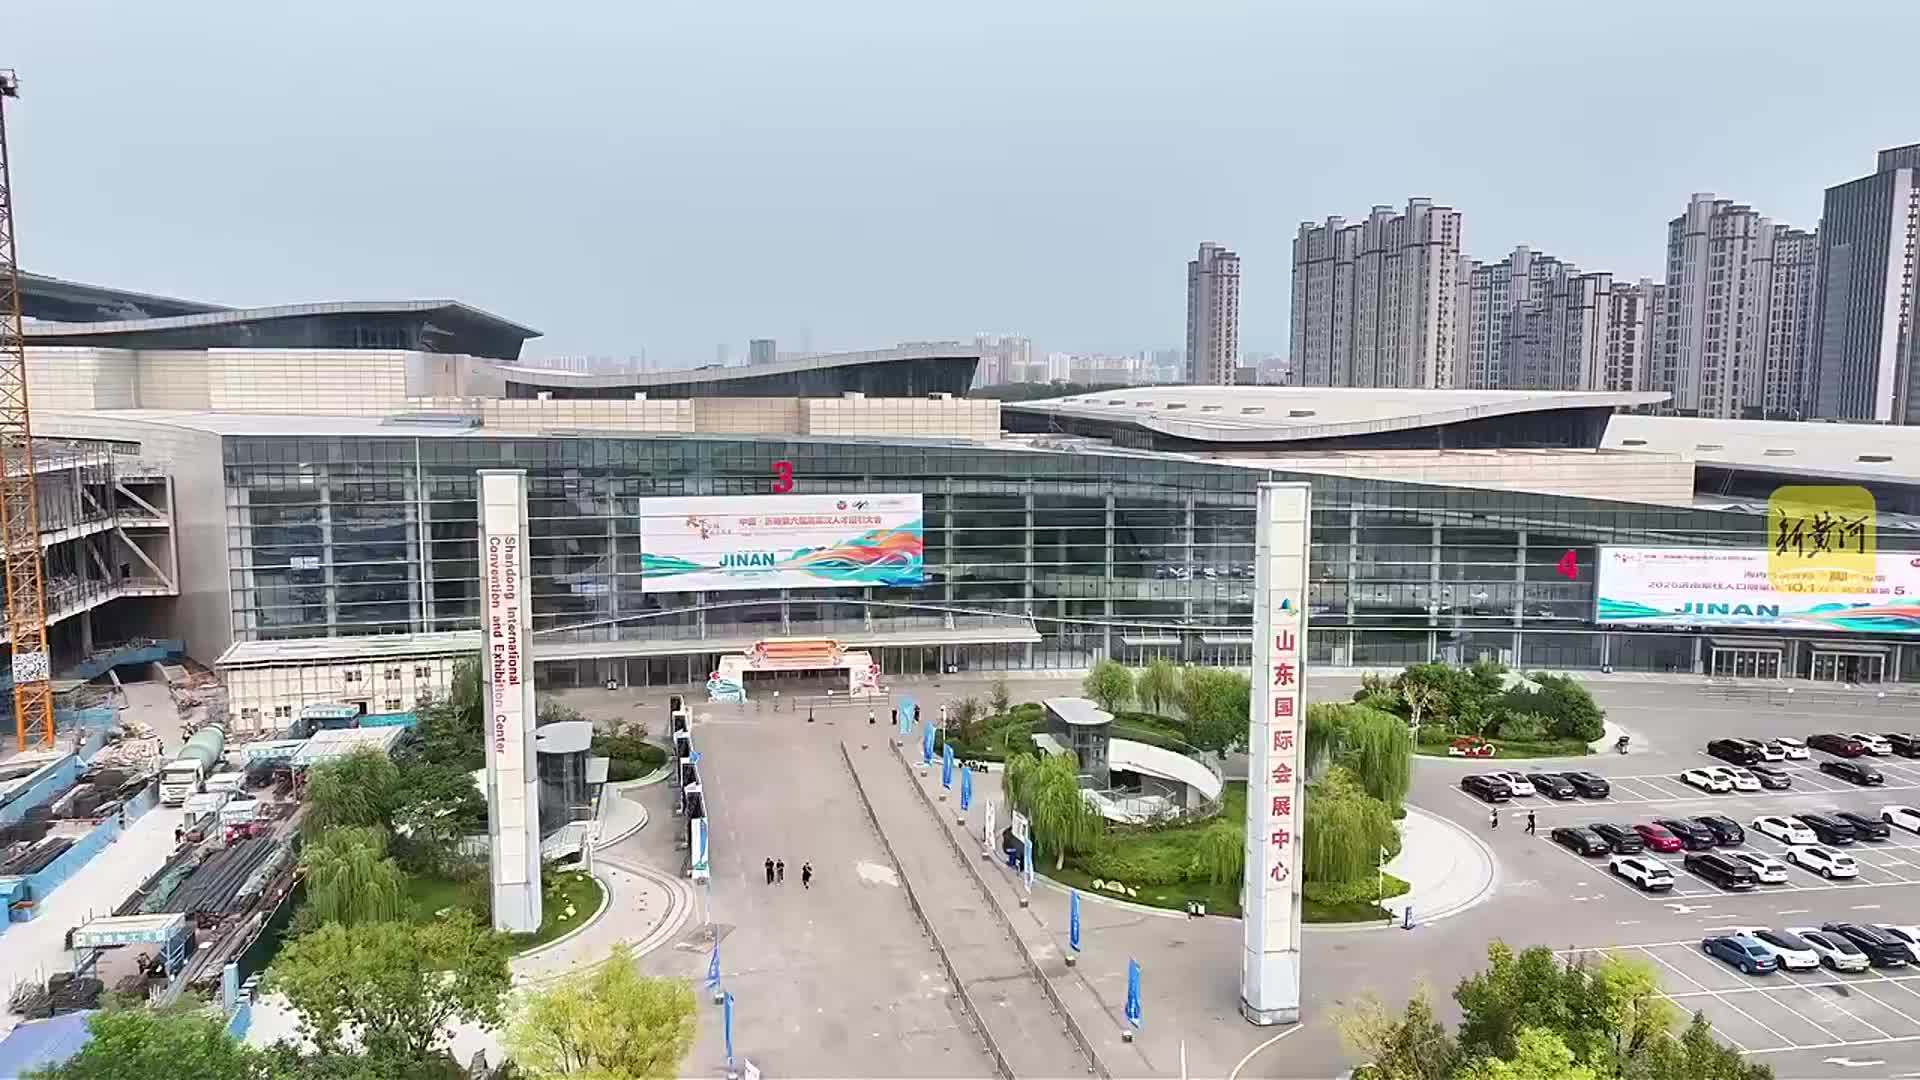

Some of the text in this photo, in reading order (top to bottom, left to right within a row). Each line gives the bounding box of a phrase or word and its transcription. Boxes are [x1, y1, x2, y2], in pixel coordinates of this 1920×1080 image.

[771, 460, 793, 493] 3
[718, 551, 776, 568] JINAN
[1556, 549, 1579, 581] 4
[504, 536, 521, 687] Shandong International
[1675, 602, 1780, 617] JINAN
[488, 536, 506, 754] Convention and Exhibition Center
[1269, 629, 1296, 882] 山东国际会展中心
